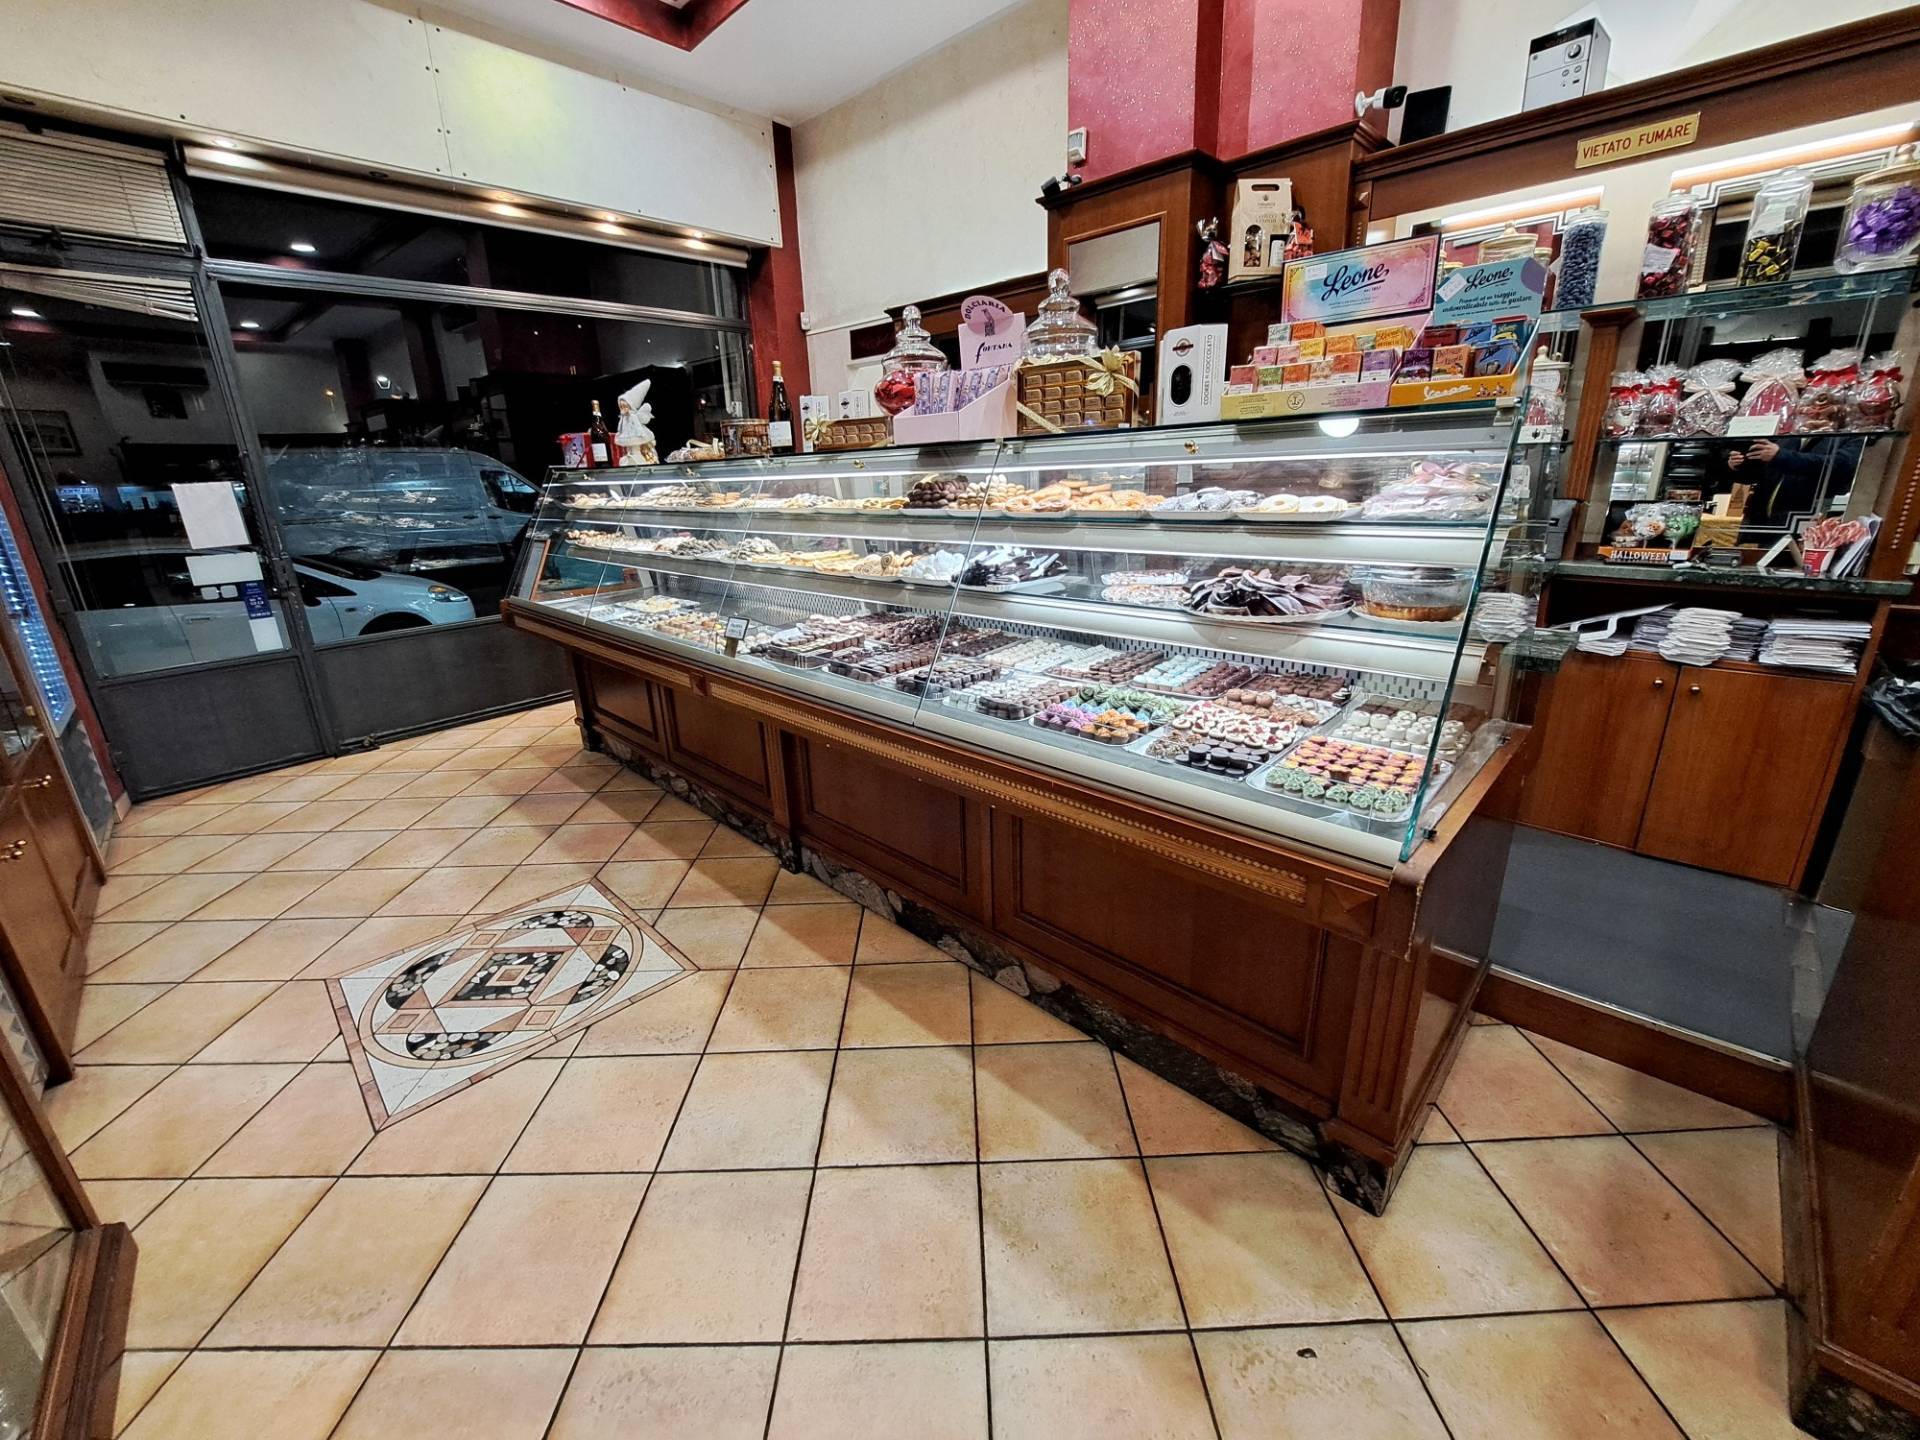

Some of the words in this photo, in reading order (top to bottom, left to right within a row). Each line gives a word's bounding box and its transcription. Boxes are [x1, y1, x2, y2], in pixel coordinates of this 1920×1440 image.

[1583, 137, 1632, 159] VIETATO
[1638, 122, 1692, 146] FUMARE
[1321, 263, 1390, 301] Leone
[1464, 267, 1514, 292] Leone
[965, 300, 1006, 320] DOLCIARIA
[1610, 550, 1669, 561] HALLOWEEN
